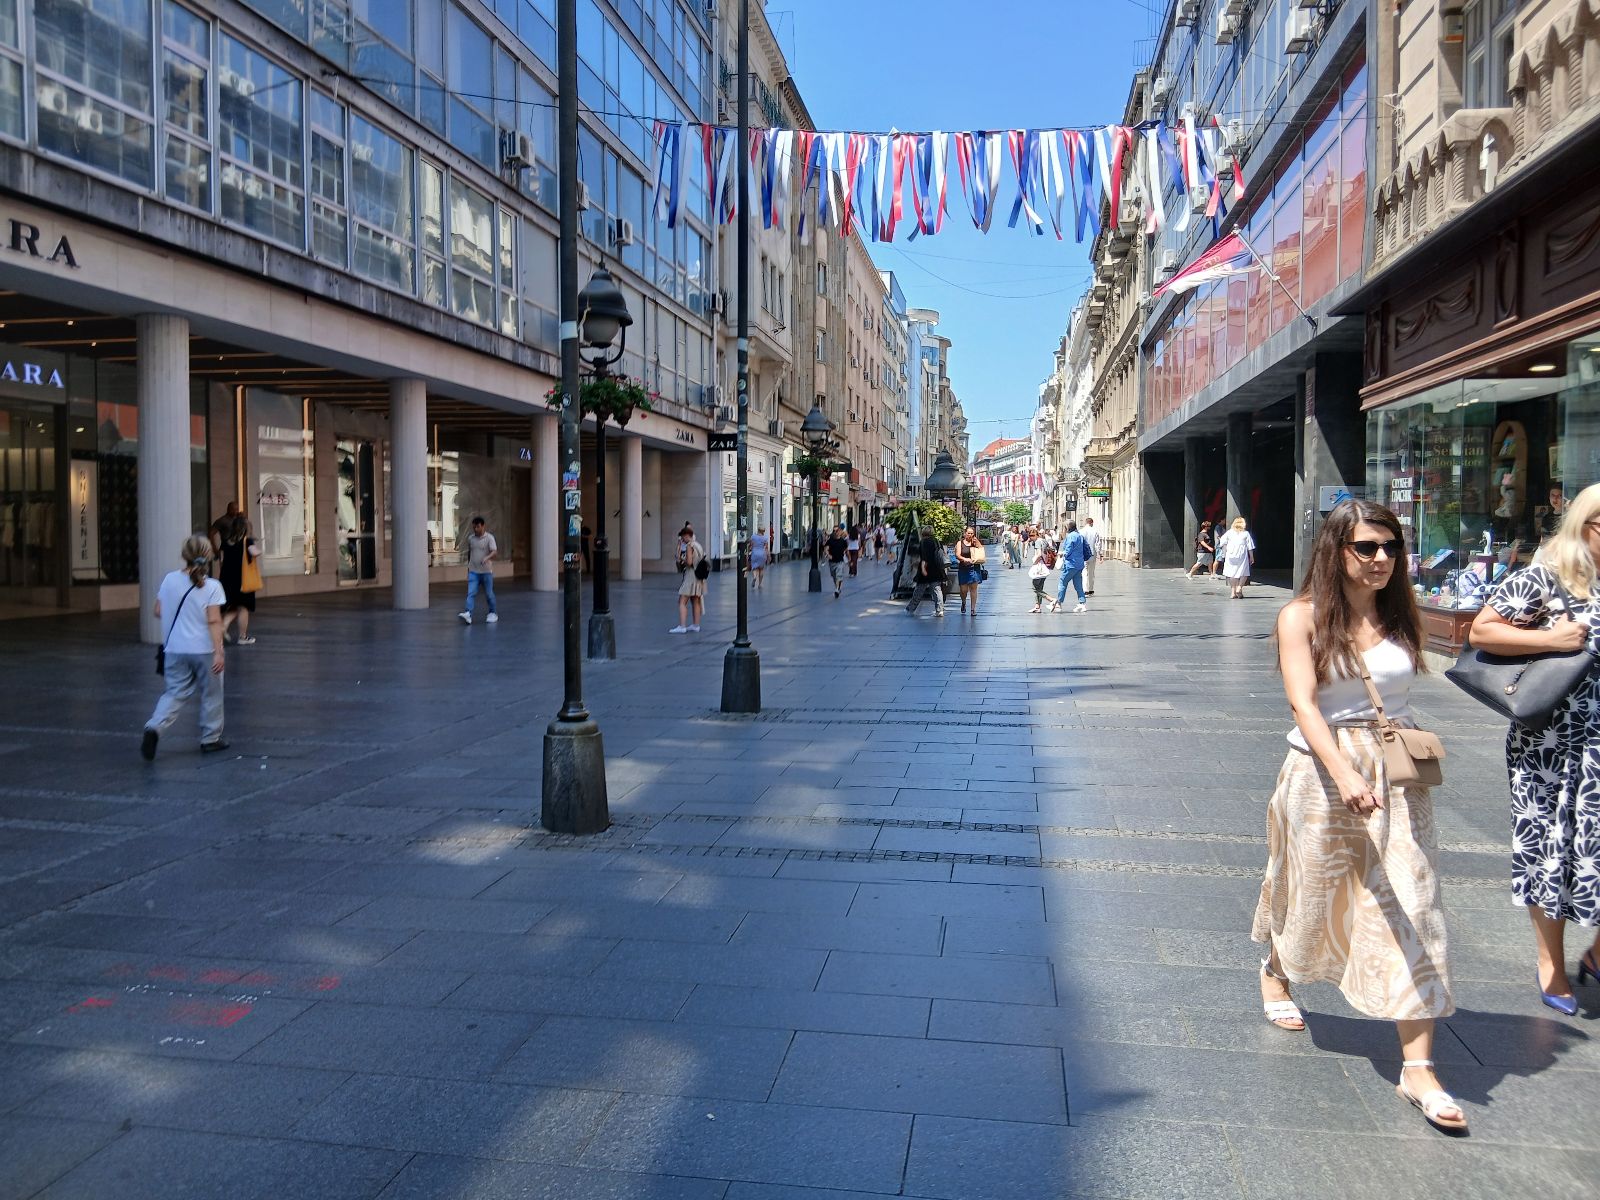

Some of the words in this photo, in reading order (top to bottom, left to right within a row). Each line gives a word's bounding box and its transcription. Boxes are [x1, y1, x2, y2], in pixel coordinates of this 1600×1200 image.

[0, 218, 81, 269] RA
[520, 447, 532, 461] ZA
[1433, 445, 1485, 457] Serian
